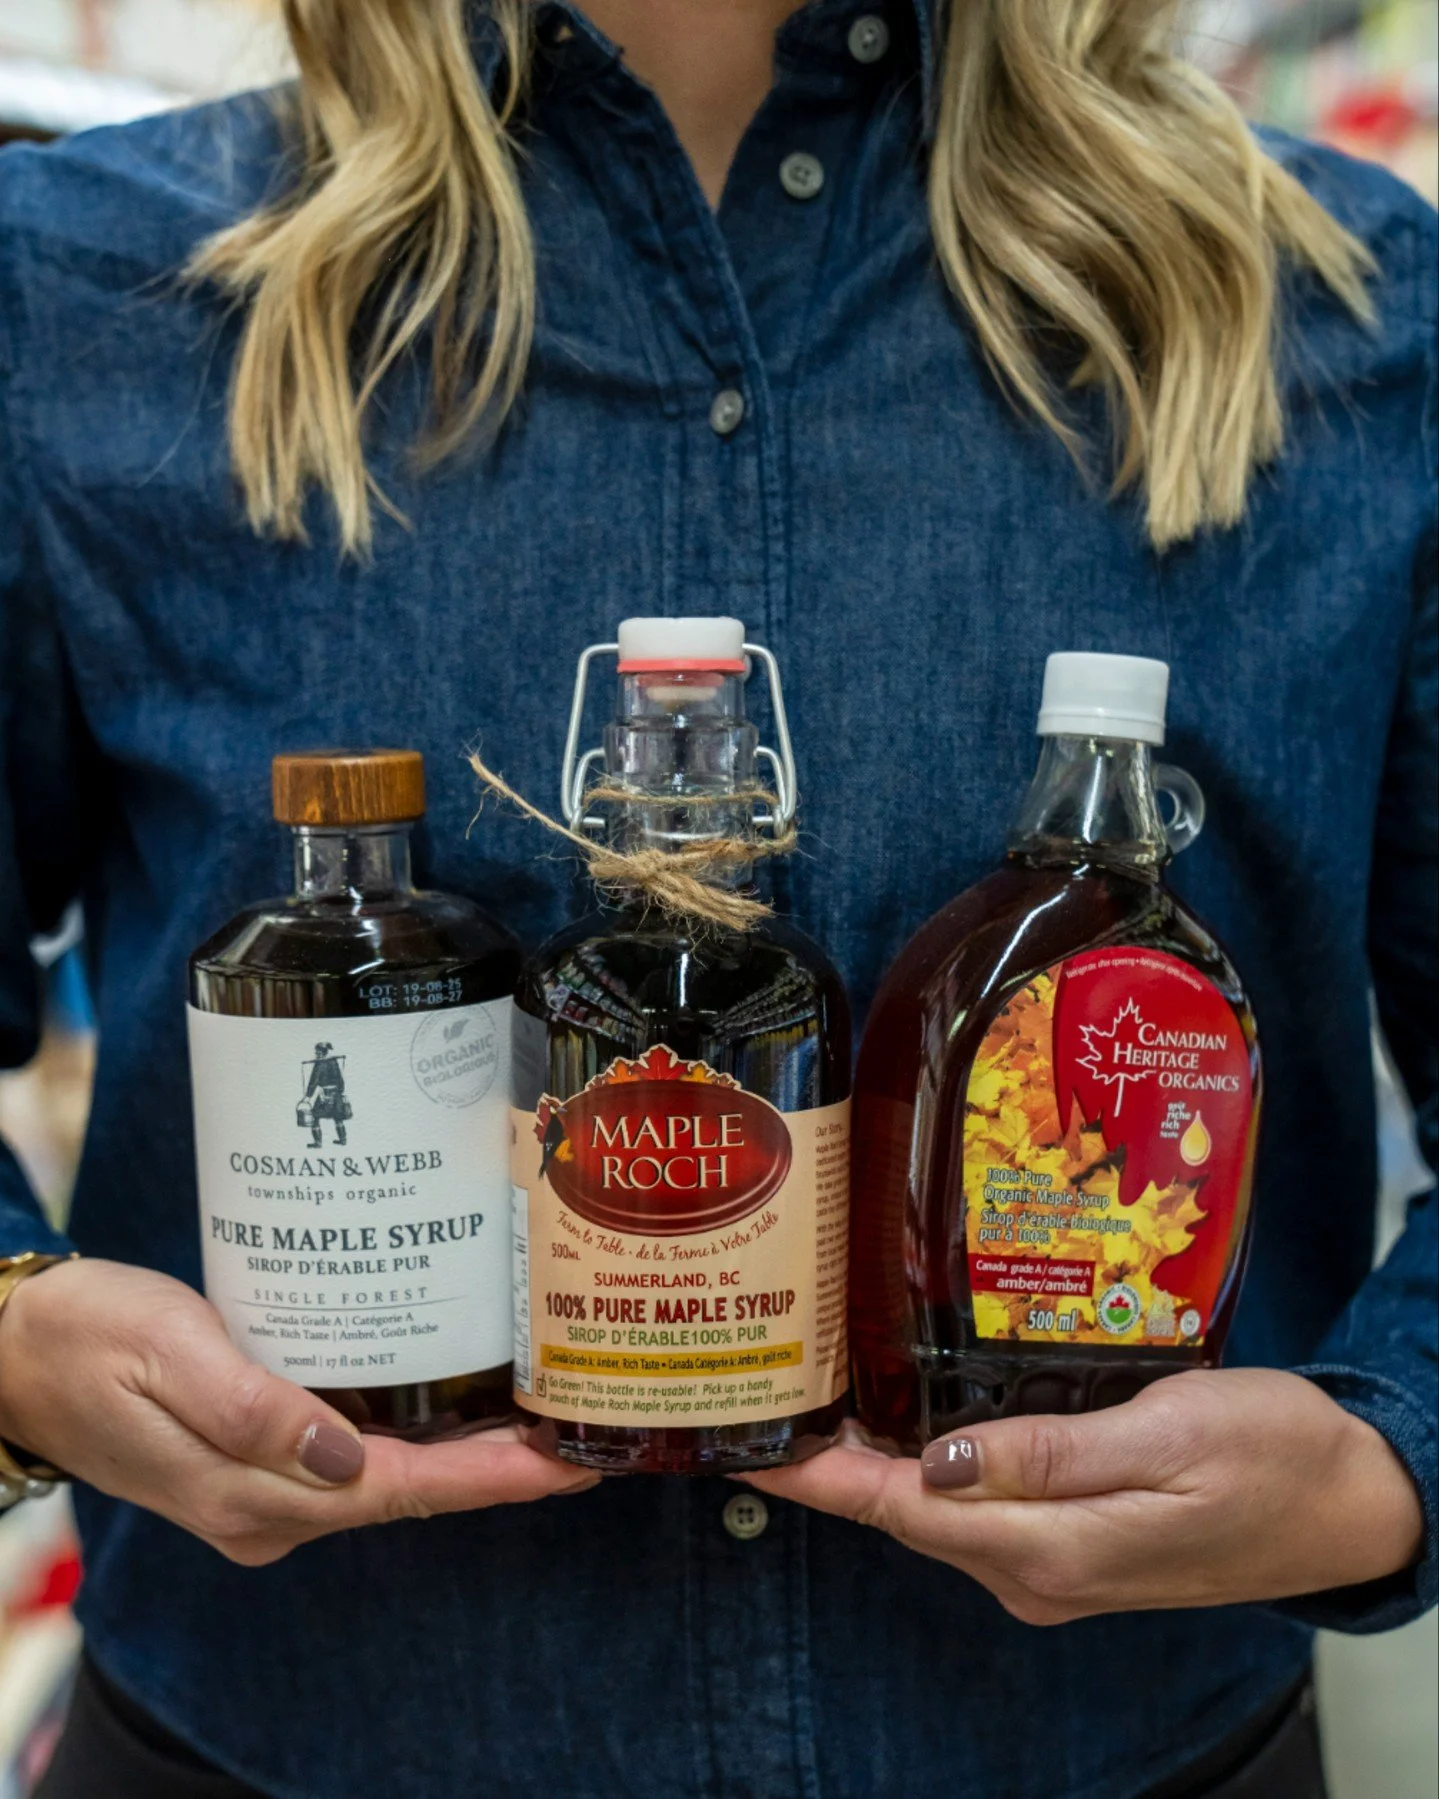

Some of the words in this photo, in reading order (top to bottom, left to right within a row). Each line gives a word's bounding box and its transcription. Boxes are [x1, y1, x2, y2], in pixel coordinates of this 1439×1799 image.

[359, 984, 397, 998] LOT:
[368, 997, 397, 1009] BB:
[1138, 1022, 1227, 1050] CANADIAN
[417, 1033, 494, 1073] ORGANIC
[1113, 1042, 1199, 1069] HERITAGE
[1158, 1071, 1240, 1092] ORGANICS
[591, 1114, 744, 1150] MAPLE
[1161, 1120, 1180, 1130] rich
[230, 1152, 336, 1176] COSMAN
[342, 1157, 364, 1177] &
[366, 1150, 442, 1174] WEBB
[600, 1155, 728, 1190] ROCH
[987, 1168, 1020, 1184] 100%
[1024, 1170, 1052, 1186] Pure
[248, 1185, 334, 1205] townships
[346, 1183, 417, 1204] organic
[984, 1185, 1032, 1204] Organic
[1036, 1190, 1074, 1208] Maple
[1076, 1192, 1110, 1212] Syrup
[211, 1215, 264, 1248] PURE
[272, 1226, 378, 1252] MAPLE
[388, 1212, 484, 1249] SYRUP
[981, 1209, 1014, 1226] Sirop
[1018, 1211, 1070, 1229] d'érable
[1070, 1214, 1132, 1236] biologique
[596, 1234, 626, 1256] Table
[636, 1243, 651, 1260] de
[652, 1244, 666, 1260] la
[669, 1244, 710, 1262] Ferme
[720, 1230, 752, 1252] Votre
[750, 1210, 779, 1239] Table
[979, 1228, 1002, 1243] pur
[1006, 1228, 1014, 1242] à
[1018, 1229, 1050, 1244] 100%
[247, 1256, 294, 1274] SIROP
[300, 1257, 387, 1275] D'ÉRABLE
[394, 1254, 430, 1272] PUR
[976, 1260, 1008, 1272] Canada
[1010, 1263, 1034, 1276] grade
[1084, 1267, 1091, 1276] A
[594, 1272, 712, 1289] SUMMERLAND,
[720, 1270, 740, 1286] BC
[996, 1277, 1087, 1293] amber/ambré
[254, 1288, 326, 1304] SINGLE
[342, 1286, 428, 1304] FOREST
[546, 1291, 587, 1320] 100%
[593, 1296, 646, 1324] PURE
[654, 1296, 728, 1324] MAPLE
[735, 1289, 796, 1320] SYRUP
[266, 1312, 300, 1325] Canada
[301, 1315, 330, 1326] Grade
[334, 1316, 342, 1326] A
[352, 1314, 402, 1327] Catégorie
[406, 1312, 414, 1321] A
[1028, 1310, 1054, 1330] 500
[1058, 1308, 1078, 1331] ml
[280, 1328, 300, 1340] Rich
[302, 1330, 330, 1340] Taste
[410, 1322, 439, 1335] Riche
[567, 1325, 606, 1344] SIROP
[738, 1324, 767, 1342] PUR
[284, 1354, 316, 1368] 500ml
[350, 1358, 364, 1366] oz
[368, 1352, 396, 1366] NET
[623, 1358, 638, 1370] Rich
[641, 1358, 660, 1370] Taste
[668, 1358, 694, 1370] Canada
[587, 1381, 604, 1394] This
[606, 1382, 634, 1396] bottle
[638, 1384, 645, 1396] is
[648, 1384, 697, 1396] re-usable!
[702, 1383, 722, 1394] Pick
[725, 1384, 736, 1396] up
[740, 1384, 744, 1392] a
[747, 1378, 773, 1392] handy
[608, 1398, 630, 1410] Roch
[632, 1400, 661, 1413] Maple
[664, 1398, 692, 1413] Syrup
[694, 1398, 712, 1412] and
[714, 1396, 737, 1412] refill
[740, 1394, 762, 1406] when
[765, 1392, 772, 1404] it
[774, 1390, 790, 1405] gets
